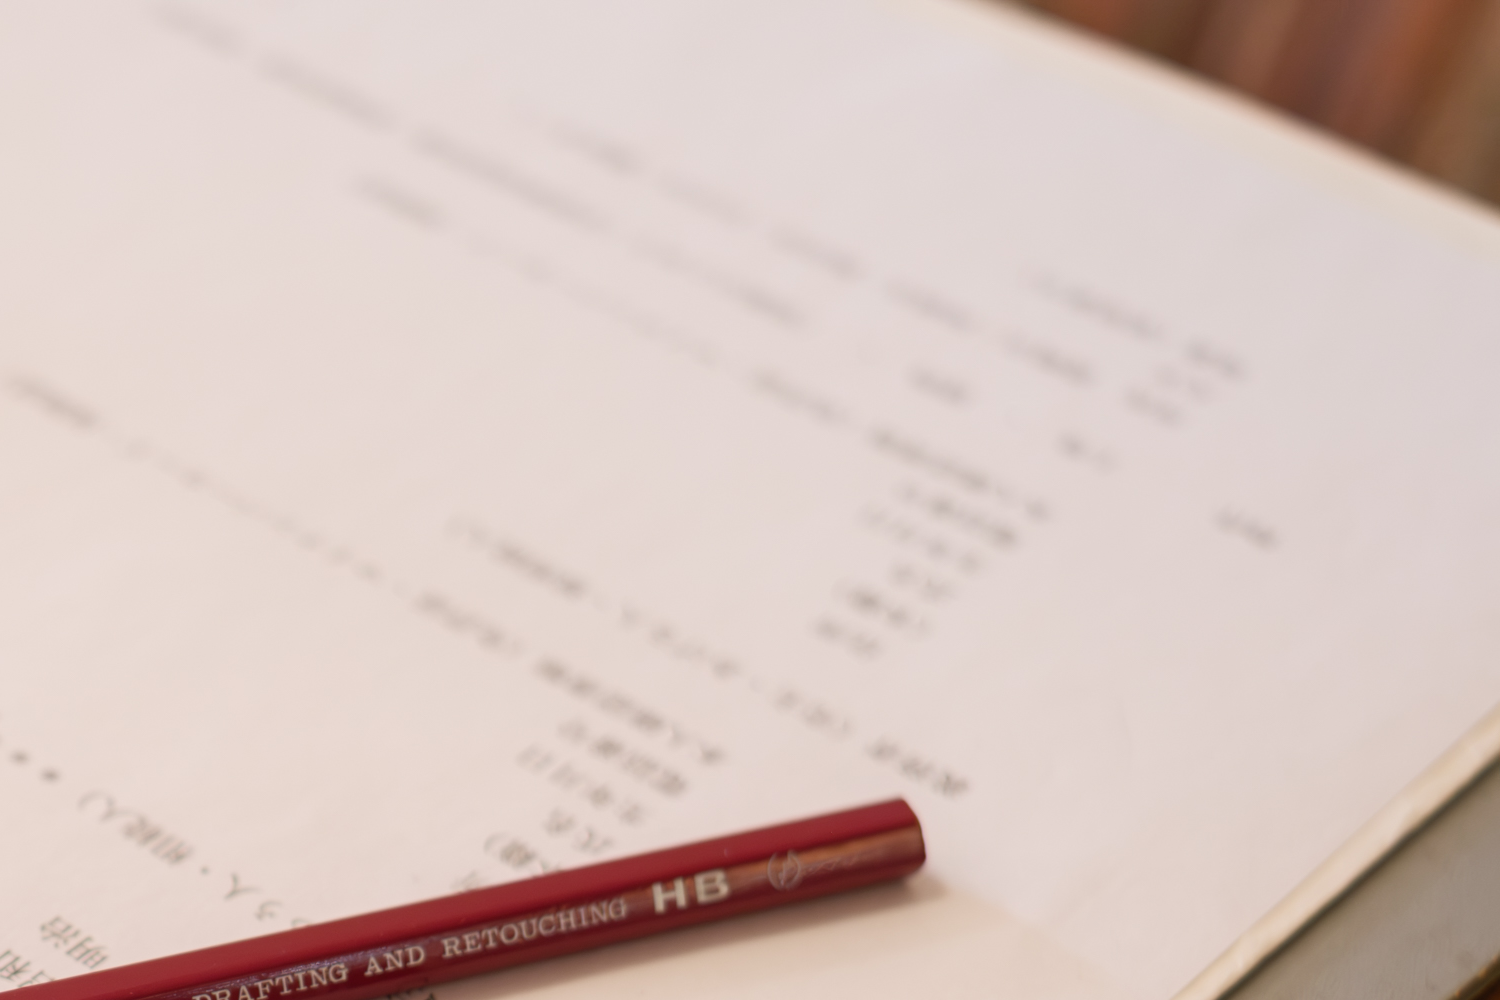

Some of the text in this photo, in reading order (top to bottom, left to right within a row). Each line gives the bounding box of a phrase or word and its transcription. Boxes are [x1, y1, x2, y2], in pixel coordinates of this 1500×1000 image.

[40, 917, 107, 970] 明治
[364, 945, 425, 976] AND
[442, 898, 627, 959] RETOUCHING
[652, 869, 731, 914] HB
